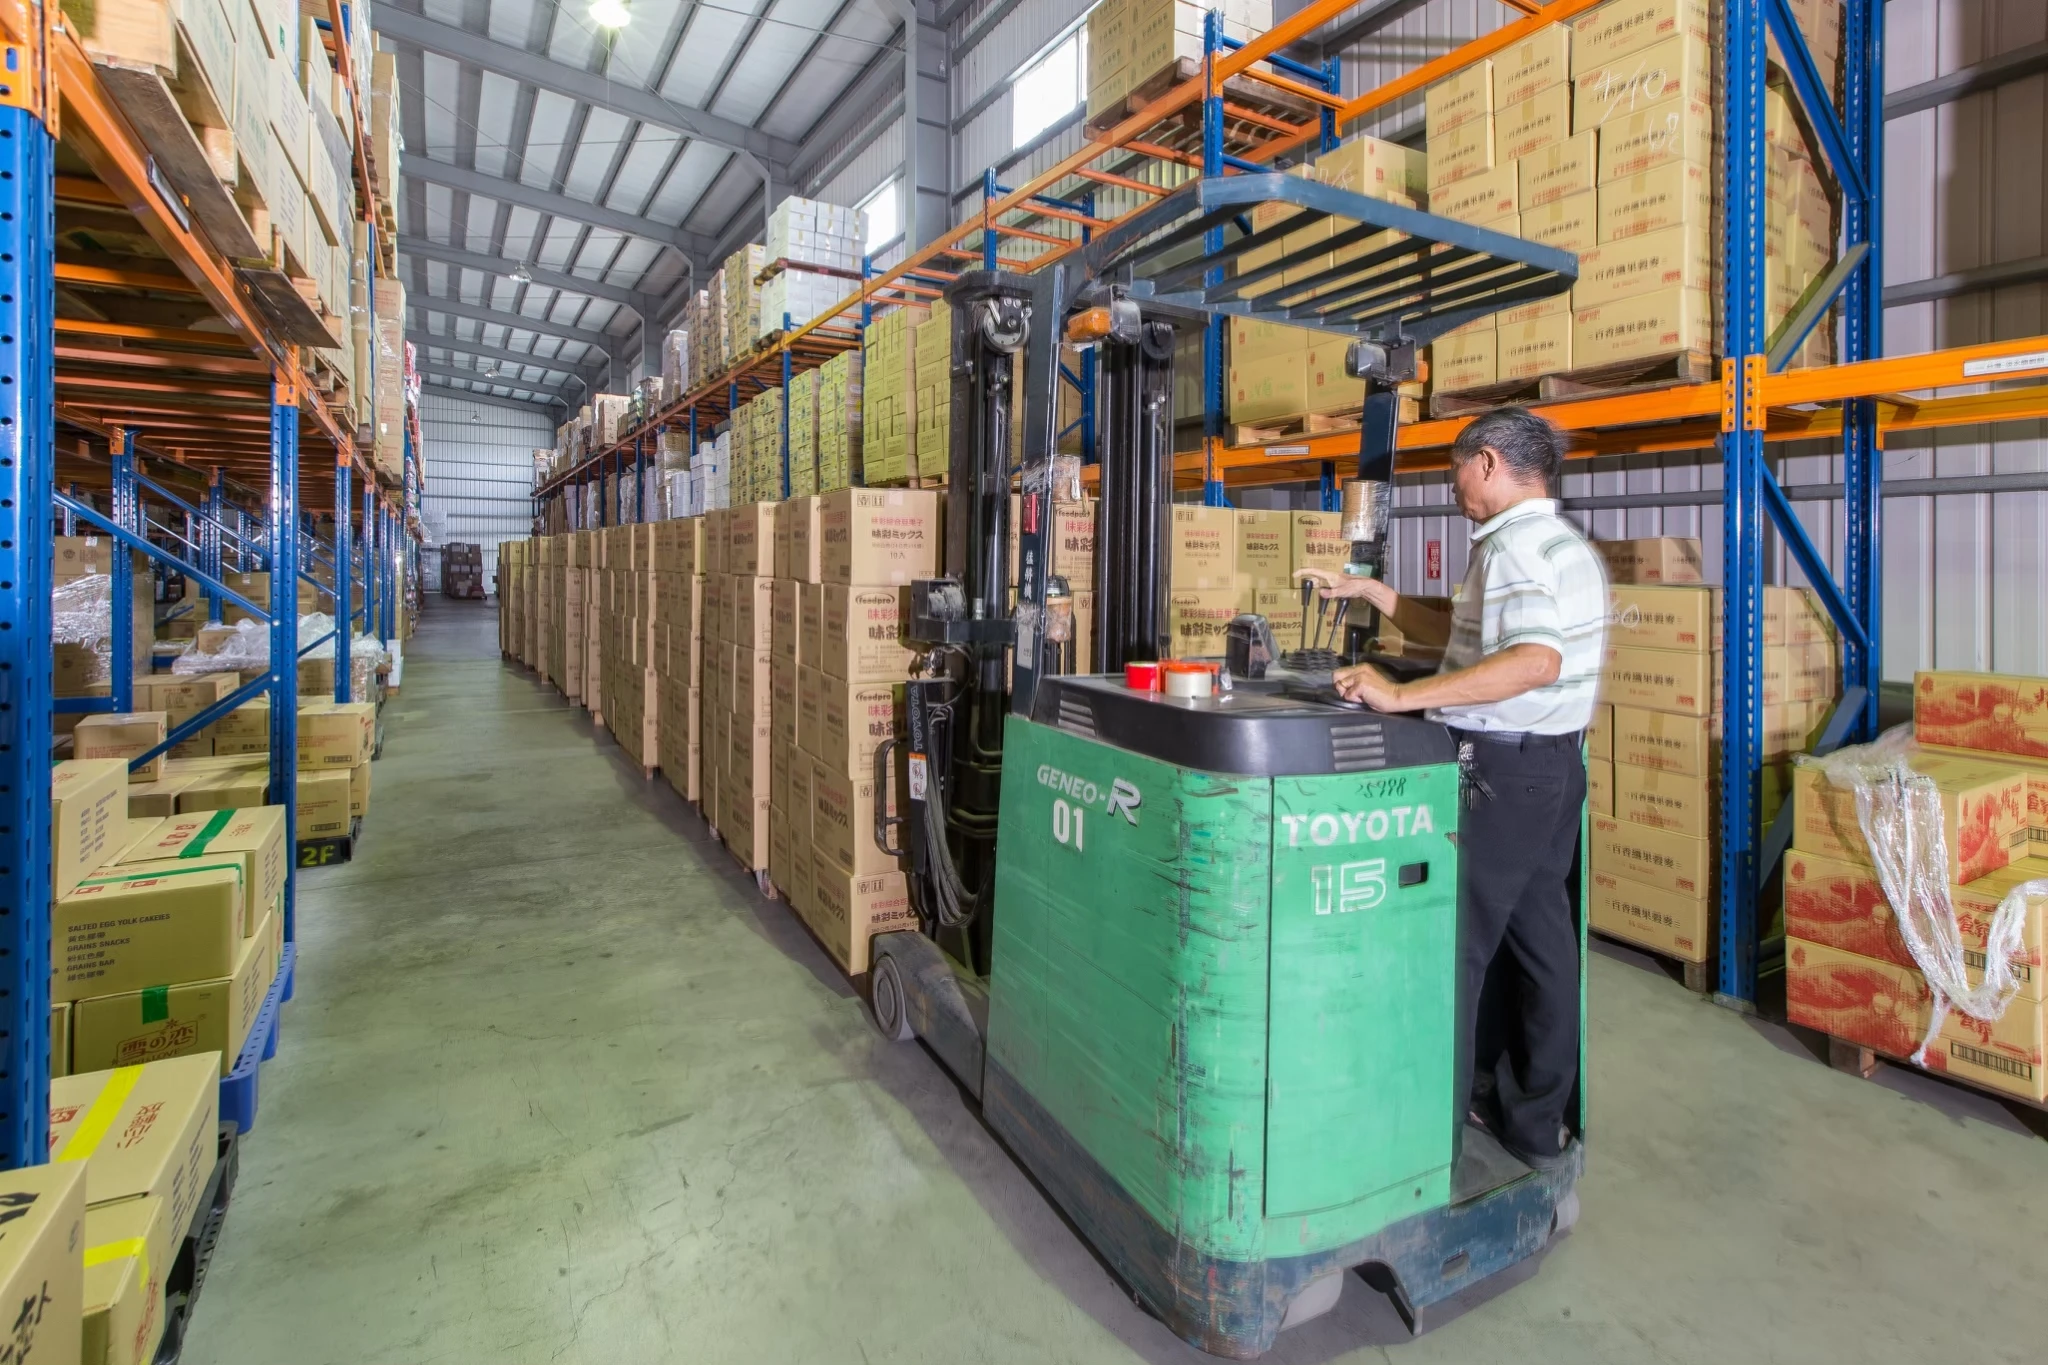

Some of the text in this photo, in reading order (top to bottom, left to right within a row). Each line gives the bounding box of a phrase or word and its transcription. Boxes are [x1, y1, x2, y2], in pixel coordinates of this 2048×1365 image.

[871, 529, 924, 540] 味彩ミックス
[910, 685, 923, 752] TOYOTA
[1053, 798, 1083, 853] 01
[1281, 804, 1434, 847] TOYOTA
[301, 845, 337, 867] 2F
[1311, 858, 1387, 916] 15
[68, 922, 98, 933] SALTED
[99, 919, 116, 929] EGG
[118, 916, 138, 926] YOLK
[67, 937, 131, 952] GRAINS SNACKS
[66, 958, 116, 972] GRAINS BAR
